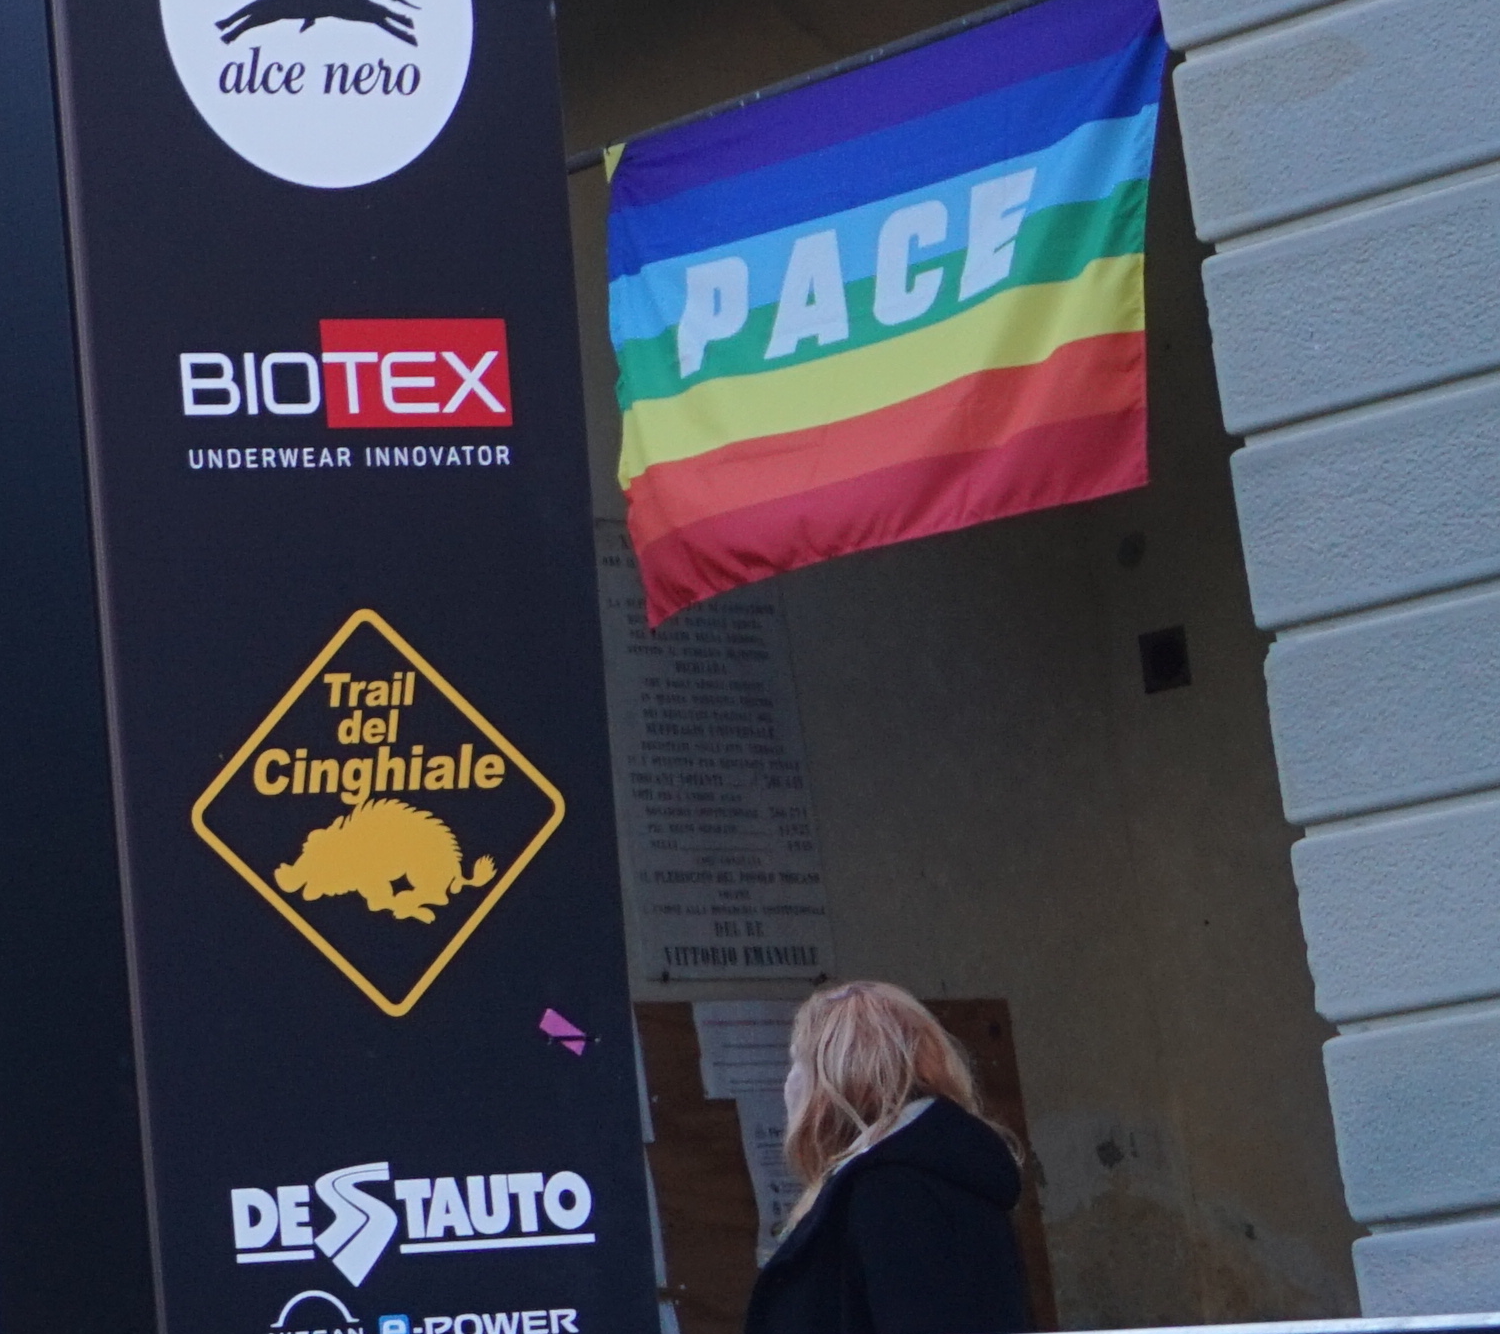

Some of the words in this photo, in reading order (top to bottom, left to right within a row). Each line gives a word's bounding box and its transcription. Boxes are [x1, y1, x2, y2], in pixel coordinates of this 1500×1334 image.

[218, 45, 305, 97] alce
[322, 58, 422, 97] nero
[676, 167, 1037, 380] PACE
[179, 350, 507, 417] BIOTEX
[188, 447, 352, 470] UNDERWEAR
[365, 444, 512, 468] INNOVATOR
[323, 670, 417, 709] Trail
[337, 709, 400, 745] del
[251, 743, 507, 806] Cinghiale
